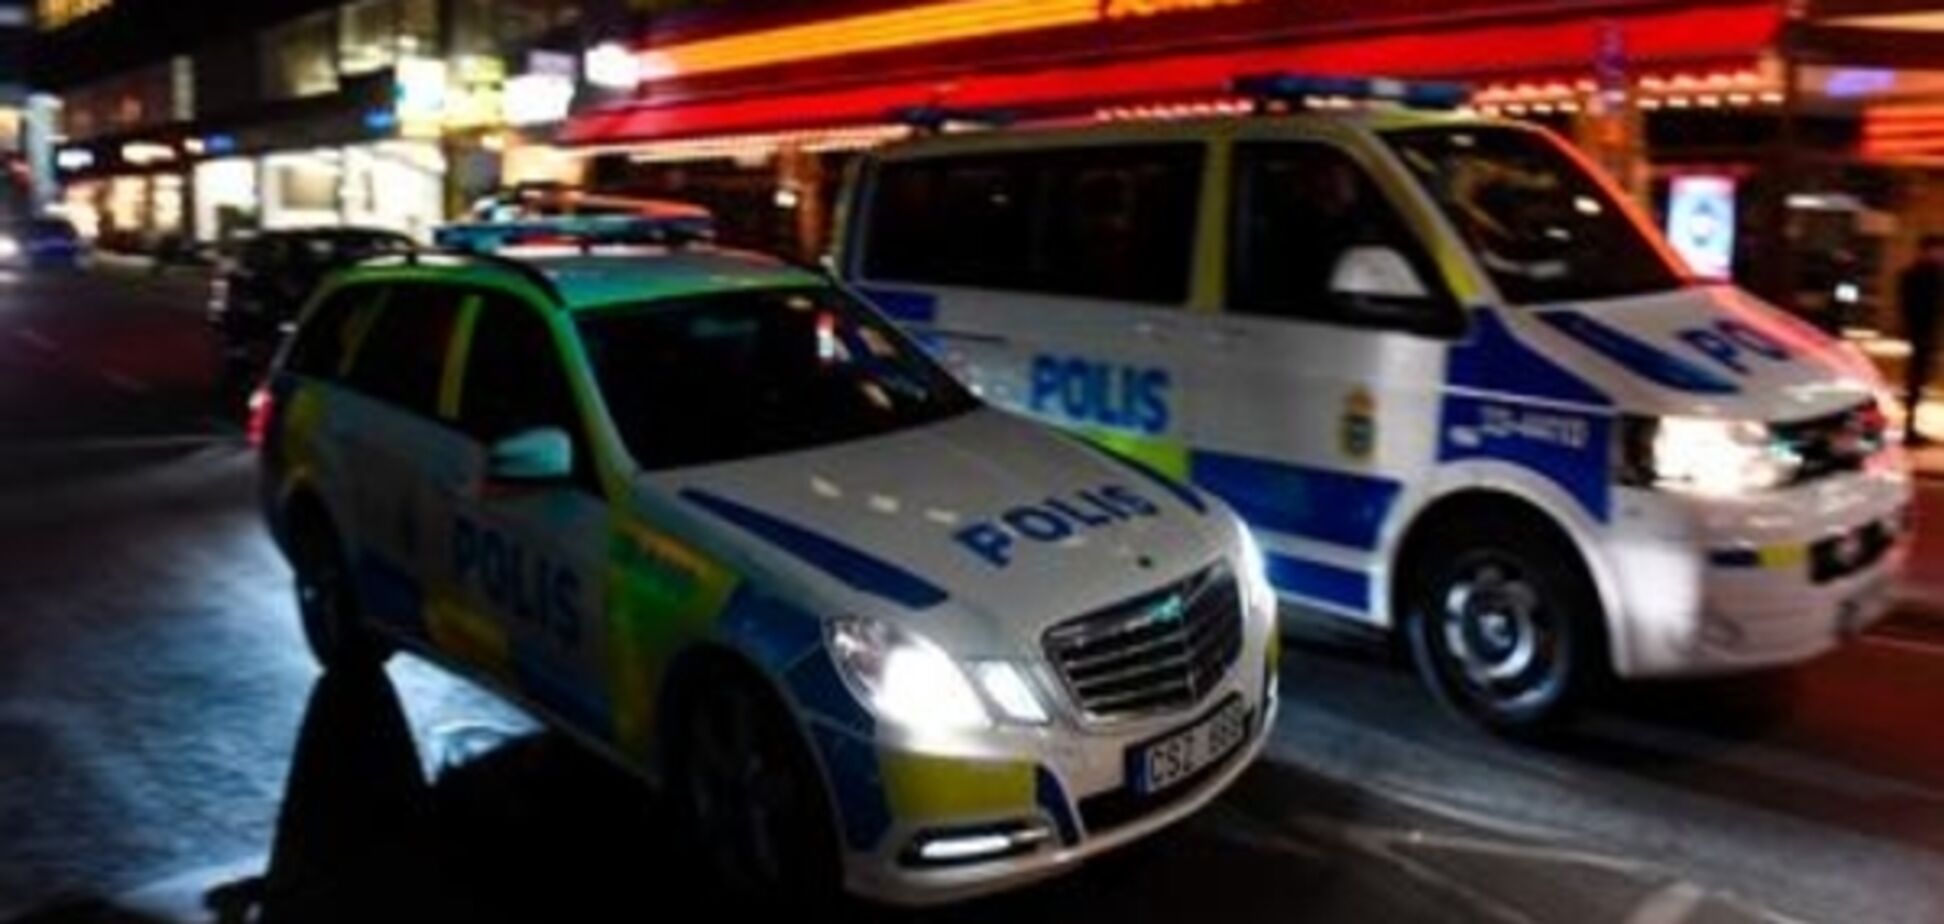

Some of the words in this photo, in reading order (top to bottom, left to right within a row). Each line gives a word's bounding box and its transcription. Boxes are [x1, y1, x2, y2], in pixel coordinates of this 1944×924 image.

[1031, 355, 1169, 434] POLIS
[954, 484, 1159, 568] POLIS
[453, 517, 581, 643] POLIS
